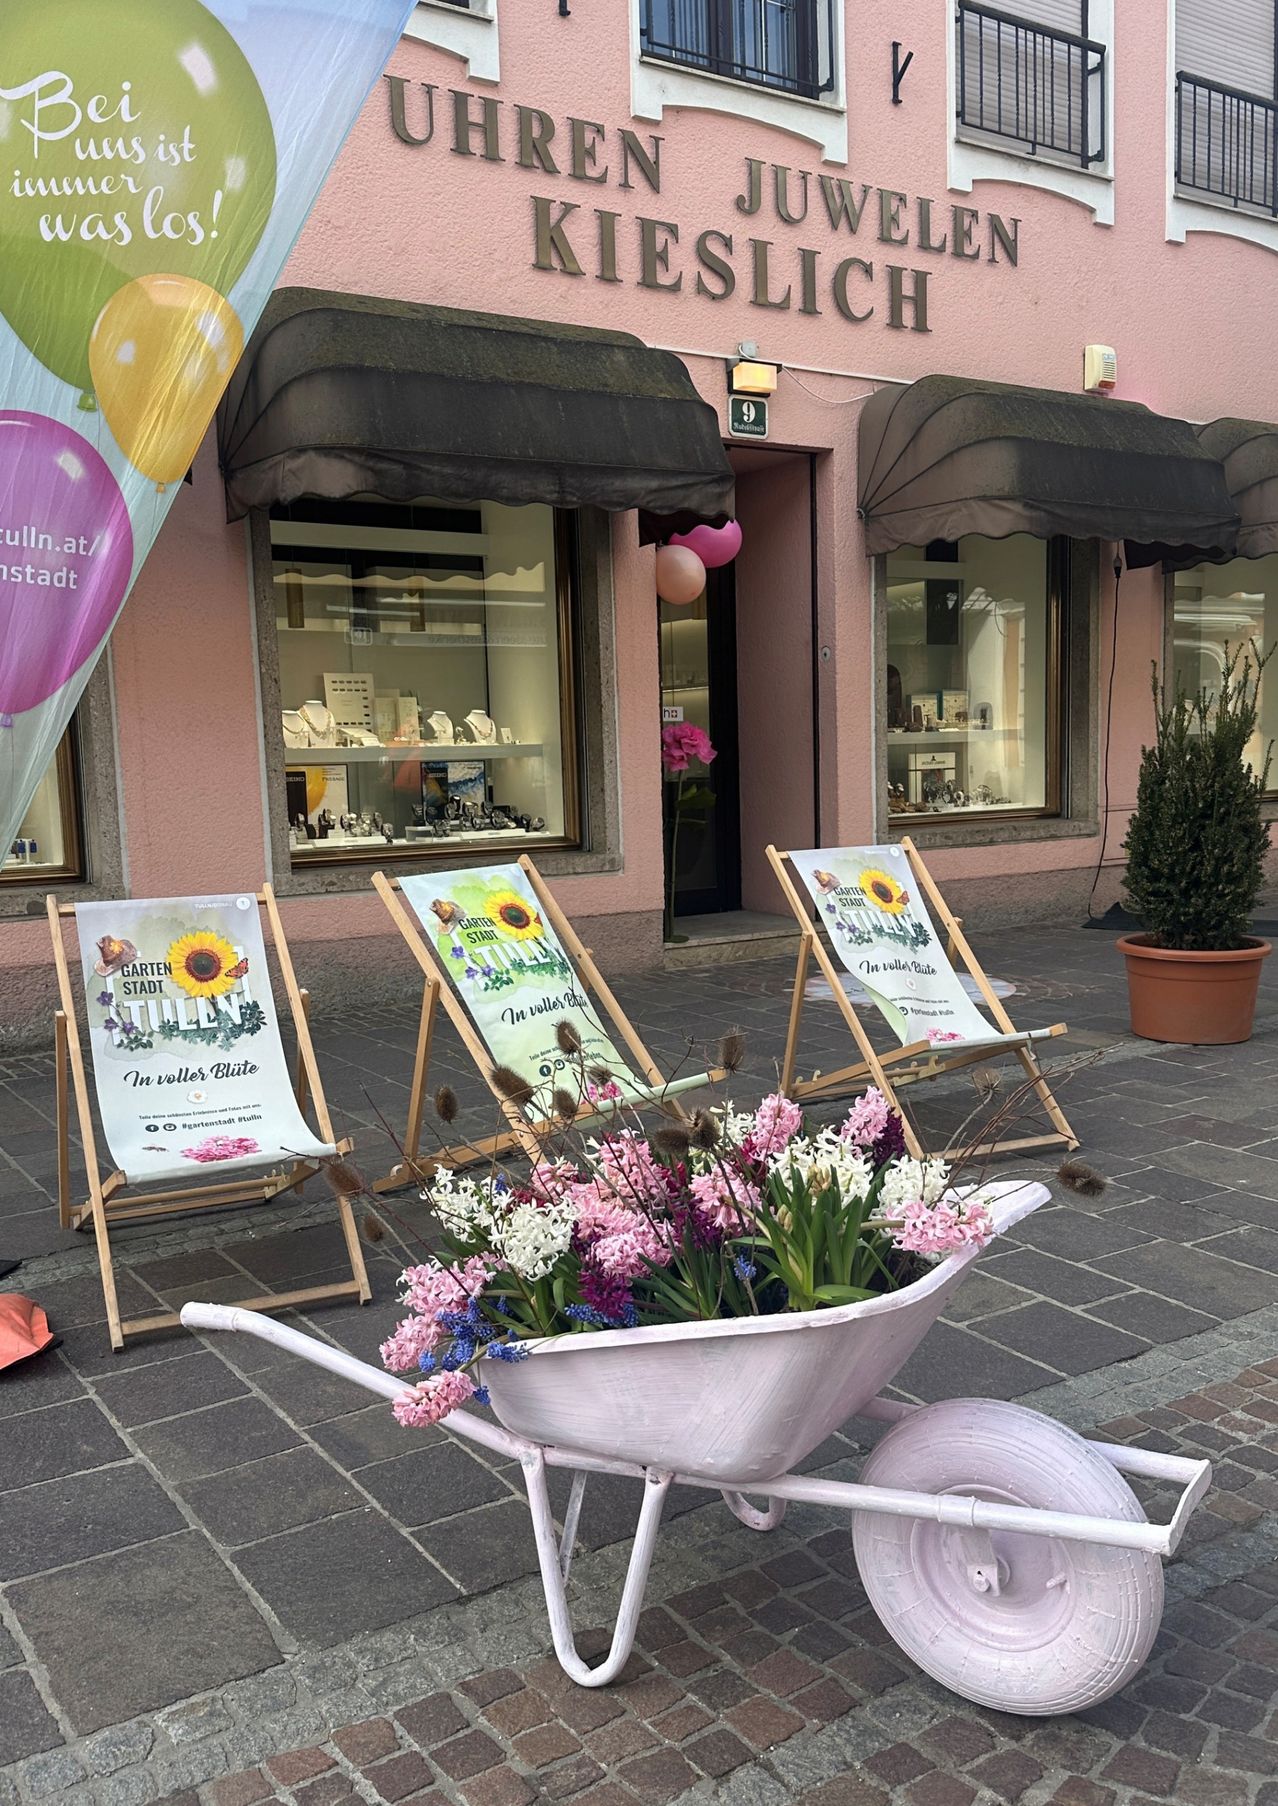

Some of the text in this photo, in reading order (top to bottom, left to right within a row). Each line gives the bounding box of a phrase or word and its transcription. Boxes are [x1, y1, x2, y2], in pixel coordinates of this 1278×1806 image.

[0, 71, 141, 159] Bei
[75, 124, 197, 166] uns ist
[9, 169, 143, 197] immer
[383, 73, 1022, 268] UHREN JUWELEN
[39, 185, 223, 246] was los!
[530, 195, 933, 333] KIESLICH
[742, 401, 756, 423] 9
[833, 886, 868, 896] GARTEN
[839, 897, 867, 907] STADT
[458, 917, 497, 930] GARTEN
[466, 929, 499, 943] STADT
[121, 961, 173, 977] GARTEN
[859, 960, 881, 974] In
[882, 958, 912, 972] voller
[123, 979, 164, 995] STADT
[123, 992, 243, 1033] TULLN
[501, 1007, 528, 1025] In
[529, 996, 566, 1017] voller
[123, 1059, 261, 1087] In voller Blüte
[182, 1114, 262, 1130] #gartenstadt #tulln
